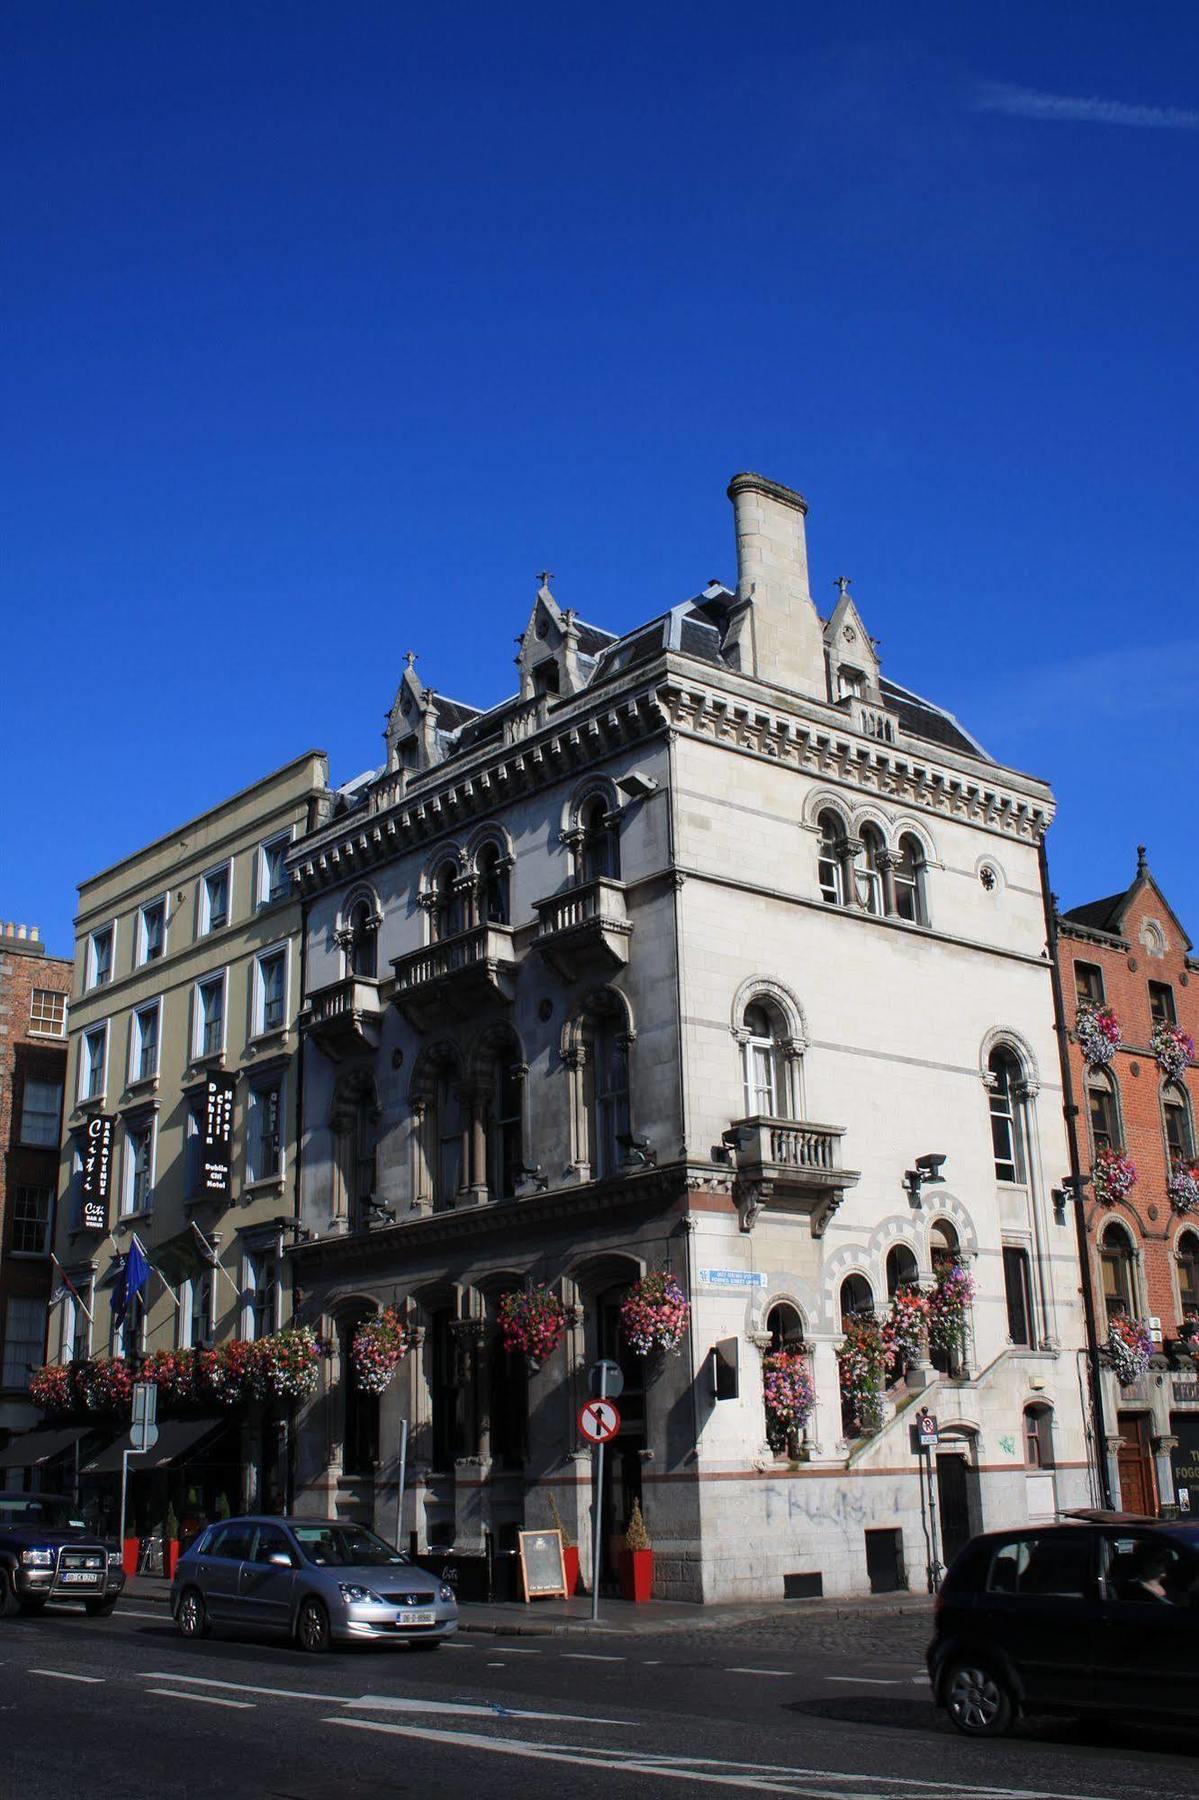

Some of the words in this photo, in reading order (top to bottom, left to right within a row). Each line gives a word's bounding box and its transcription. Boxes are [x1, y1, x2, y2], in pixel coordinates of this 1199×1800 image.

[206, 1083, 216, 1144] Dublin
[216, 1095, 224, 1135] Citi
[223, 1090, 232, 1141] Hotel
[103, 1122, 111, 1145] BAR
[84, 1119, 101, 1190] Citi
[205, 1163, 228, 1173] Dublin
[100, 1157, 108, 1195] VENUE
[206, 1180, 226, 1189] Hotel
[84, 1202, 104, 1215] Citi
